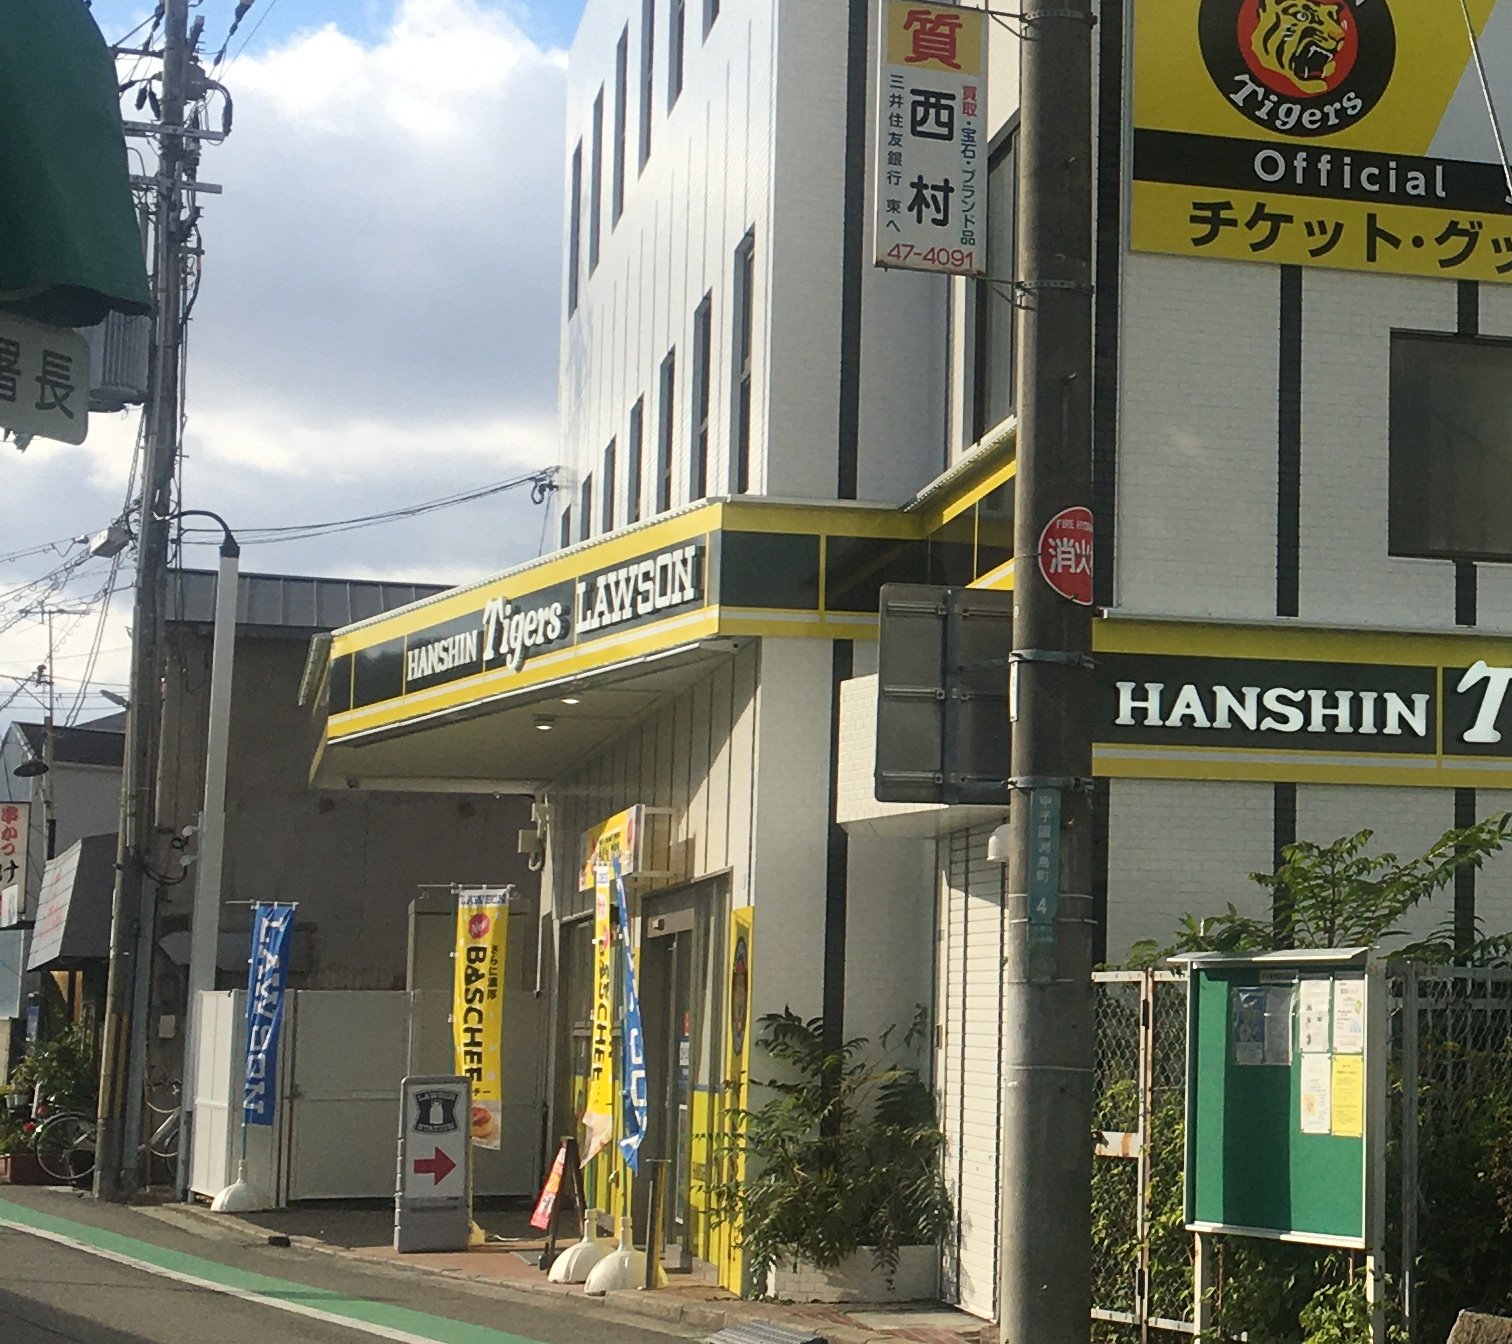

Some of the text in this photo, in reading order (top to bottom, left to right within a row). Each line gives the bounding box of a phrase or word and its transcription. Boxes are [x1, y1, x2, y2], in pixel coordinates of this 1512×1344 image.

[903, 9, 963, 70] 質
[887, 74, 904, 186] 三井住友銀行
[1229, 73, 1364, 130] Tigers
[907, 88, 956, 227] 西村
[1253, 149, 1447, 199] Official
[887, 243, 975, 269] 47-4091
[1048, 537, 1093, 575] 消火
[407, 544, 696, 681] HANSHIN Tigers LAWSON
[1114, 681, 1431, 738] HANSHIN
[1036, 897, 1048, 915] 4
